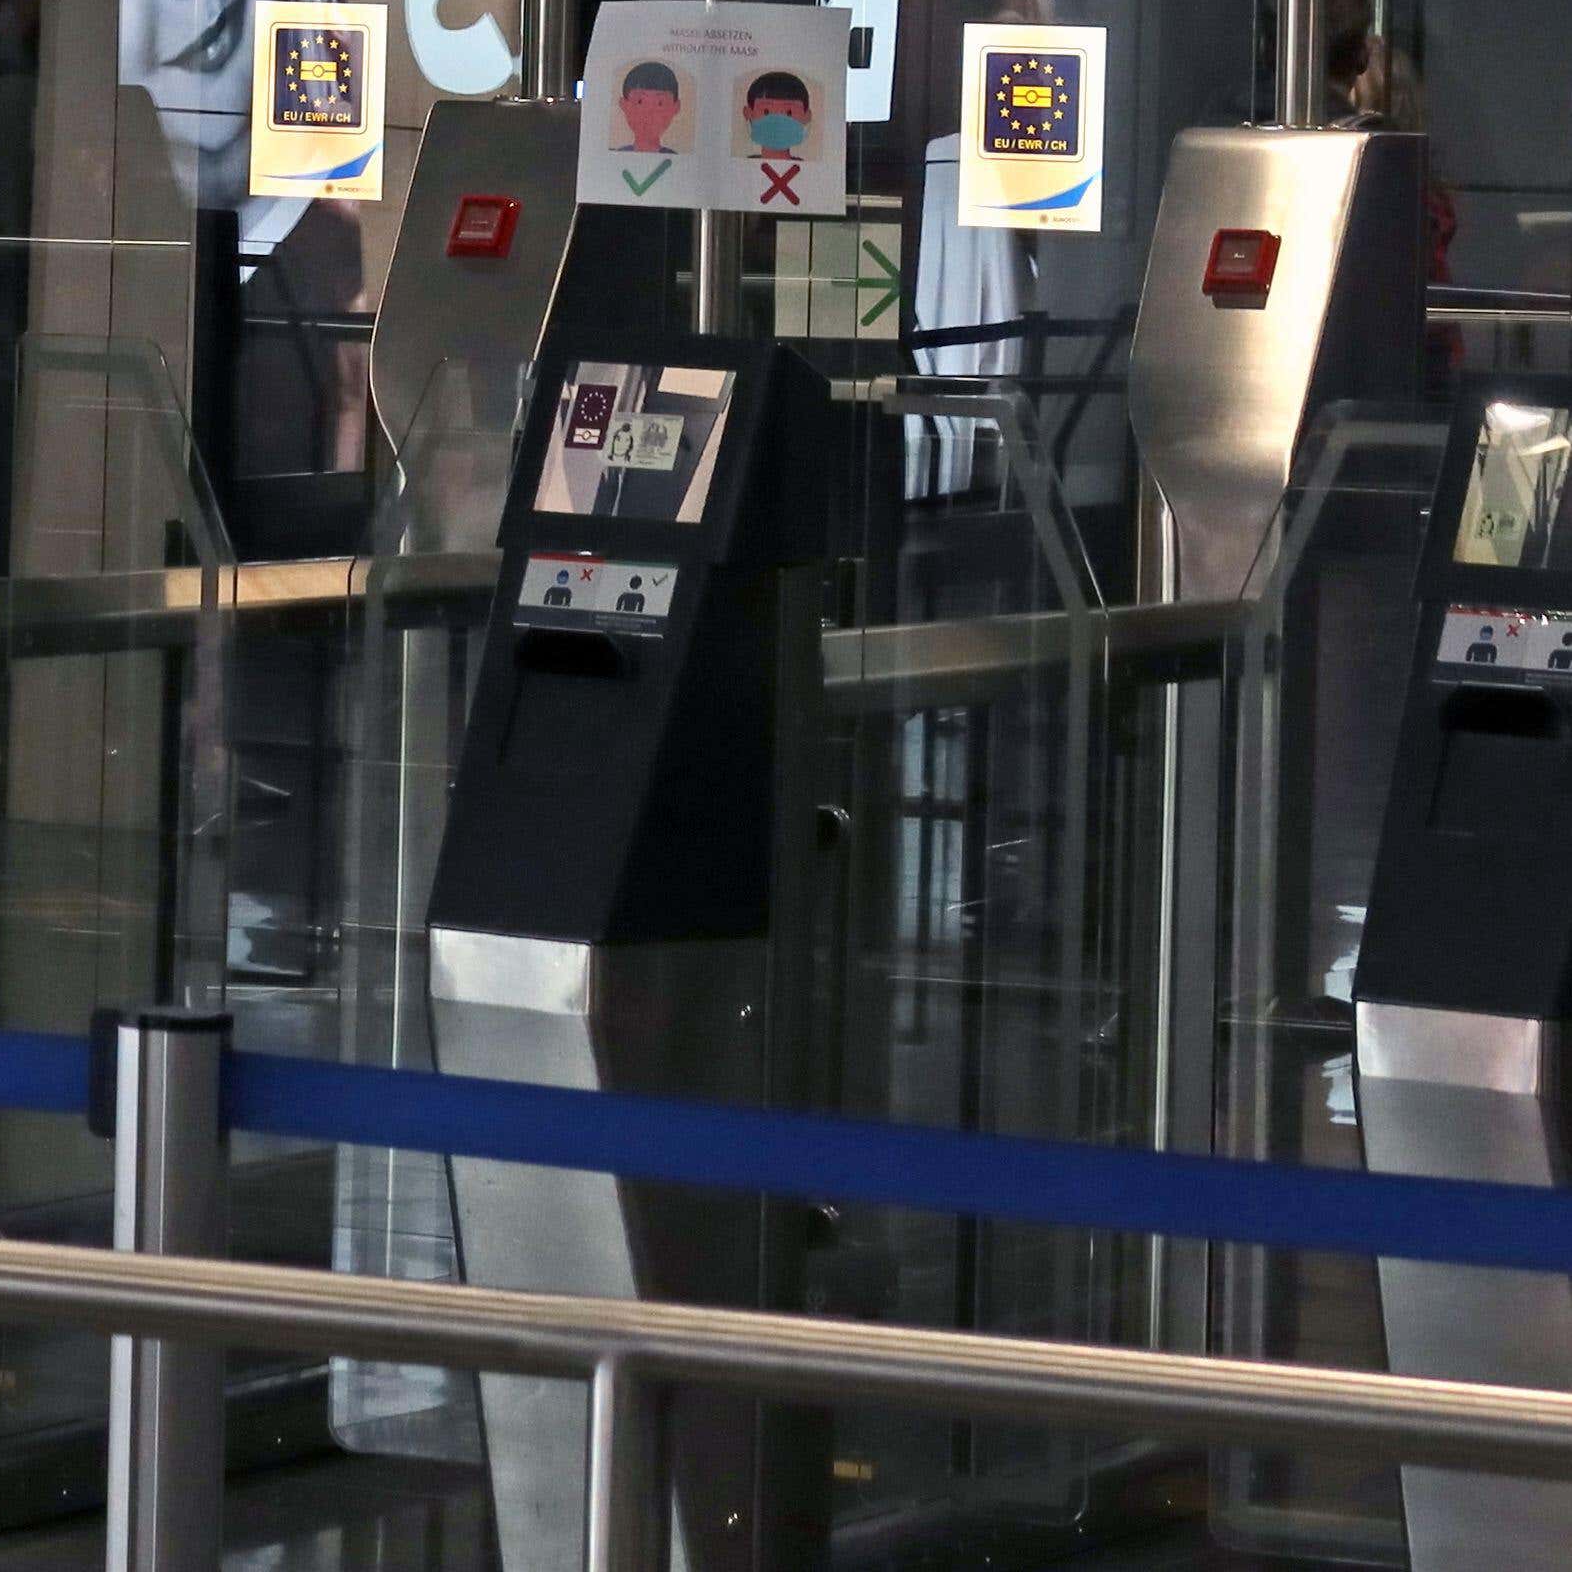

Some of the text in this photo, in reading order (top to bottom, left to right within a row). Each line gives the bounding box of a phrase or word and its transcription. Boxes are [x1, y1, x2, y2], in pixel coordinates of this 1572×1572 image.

[283, 111, 298, 122] EU
[336, 112, 352, 124] CH
[994, 138, 1009, 149] EU
[1050, 140, 1067, 151] CH
